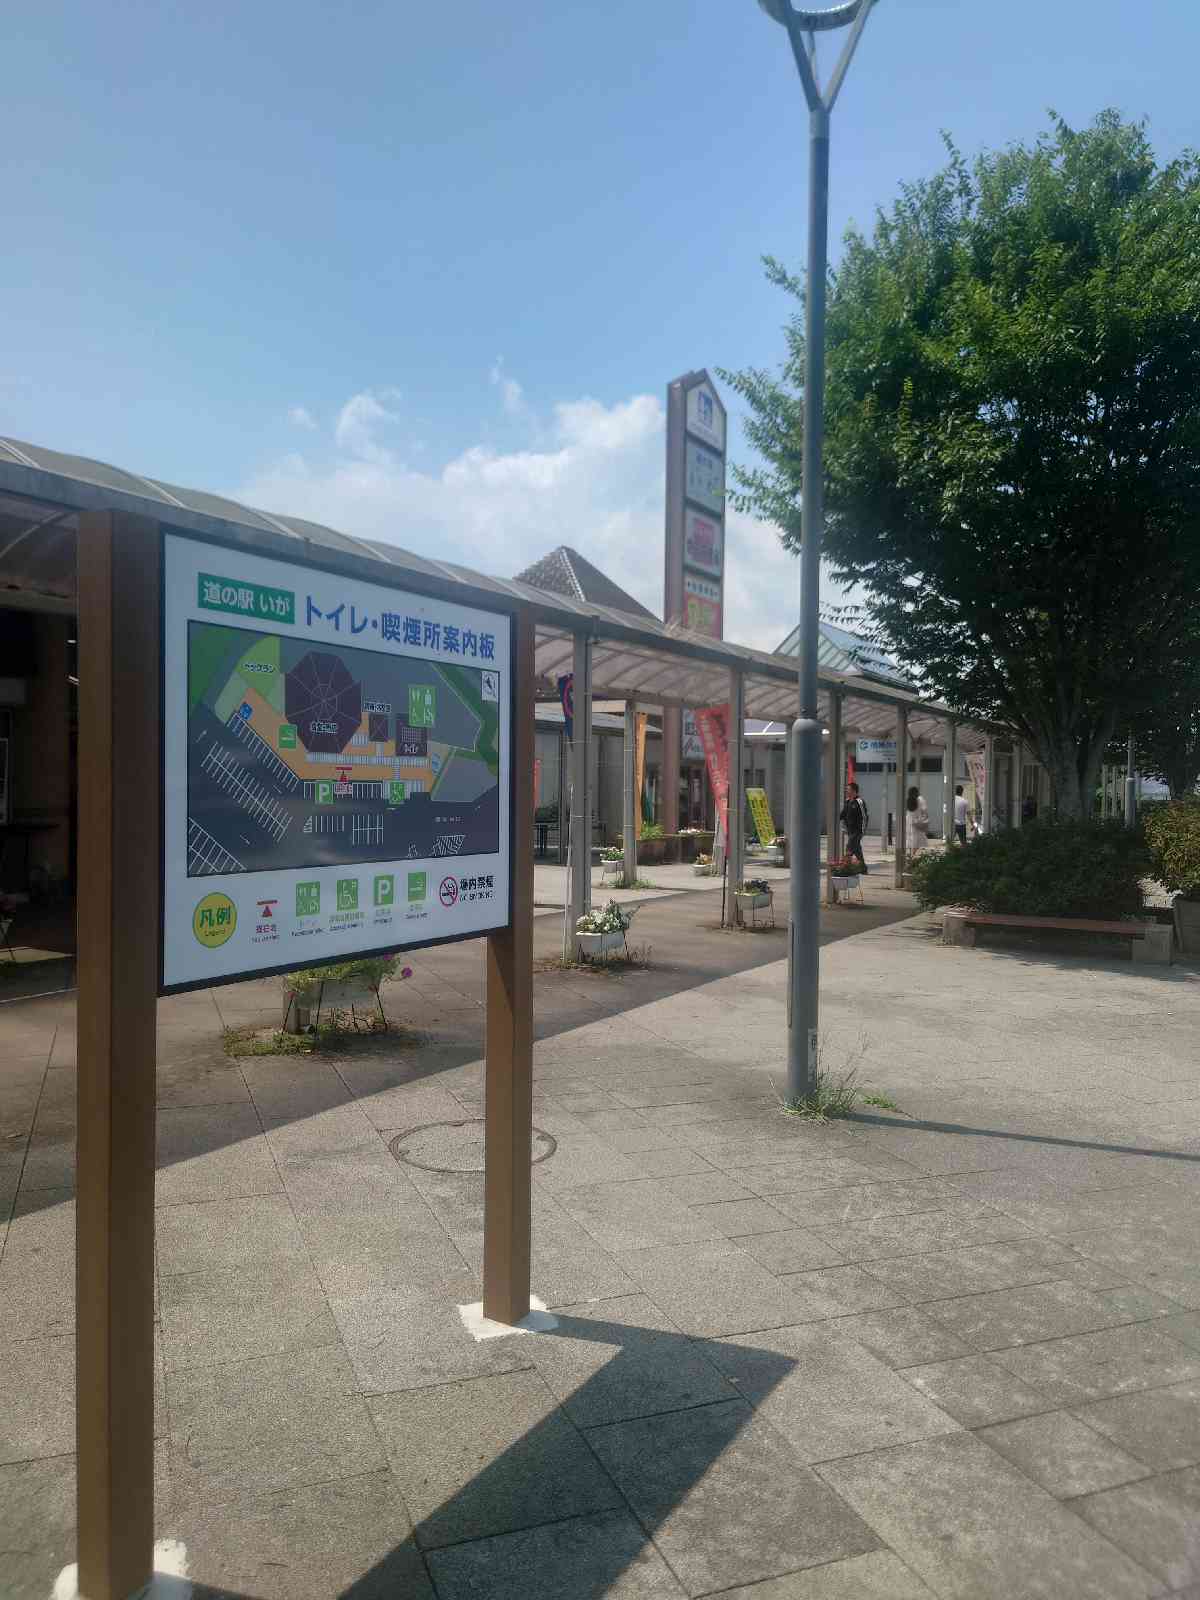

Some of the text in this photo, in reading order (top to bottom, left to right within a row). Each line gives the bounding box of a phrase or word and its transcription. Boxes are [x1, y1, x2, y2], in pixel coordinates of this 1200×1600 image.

[203, 581, 291, 617] 道の駅 いが
[305, 595, 496, 661] トイレ・喫煙所案内板
[199, 905, 232, 929] 凡例
